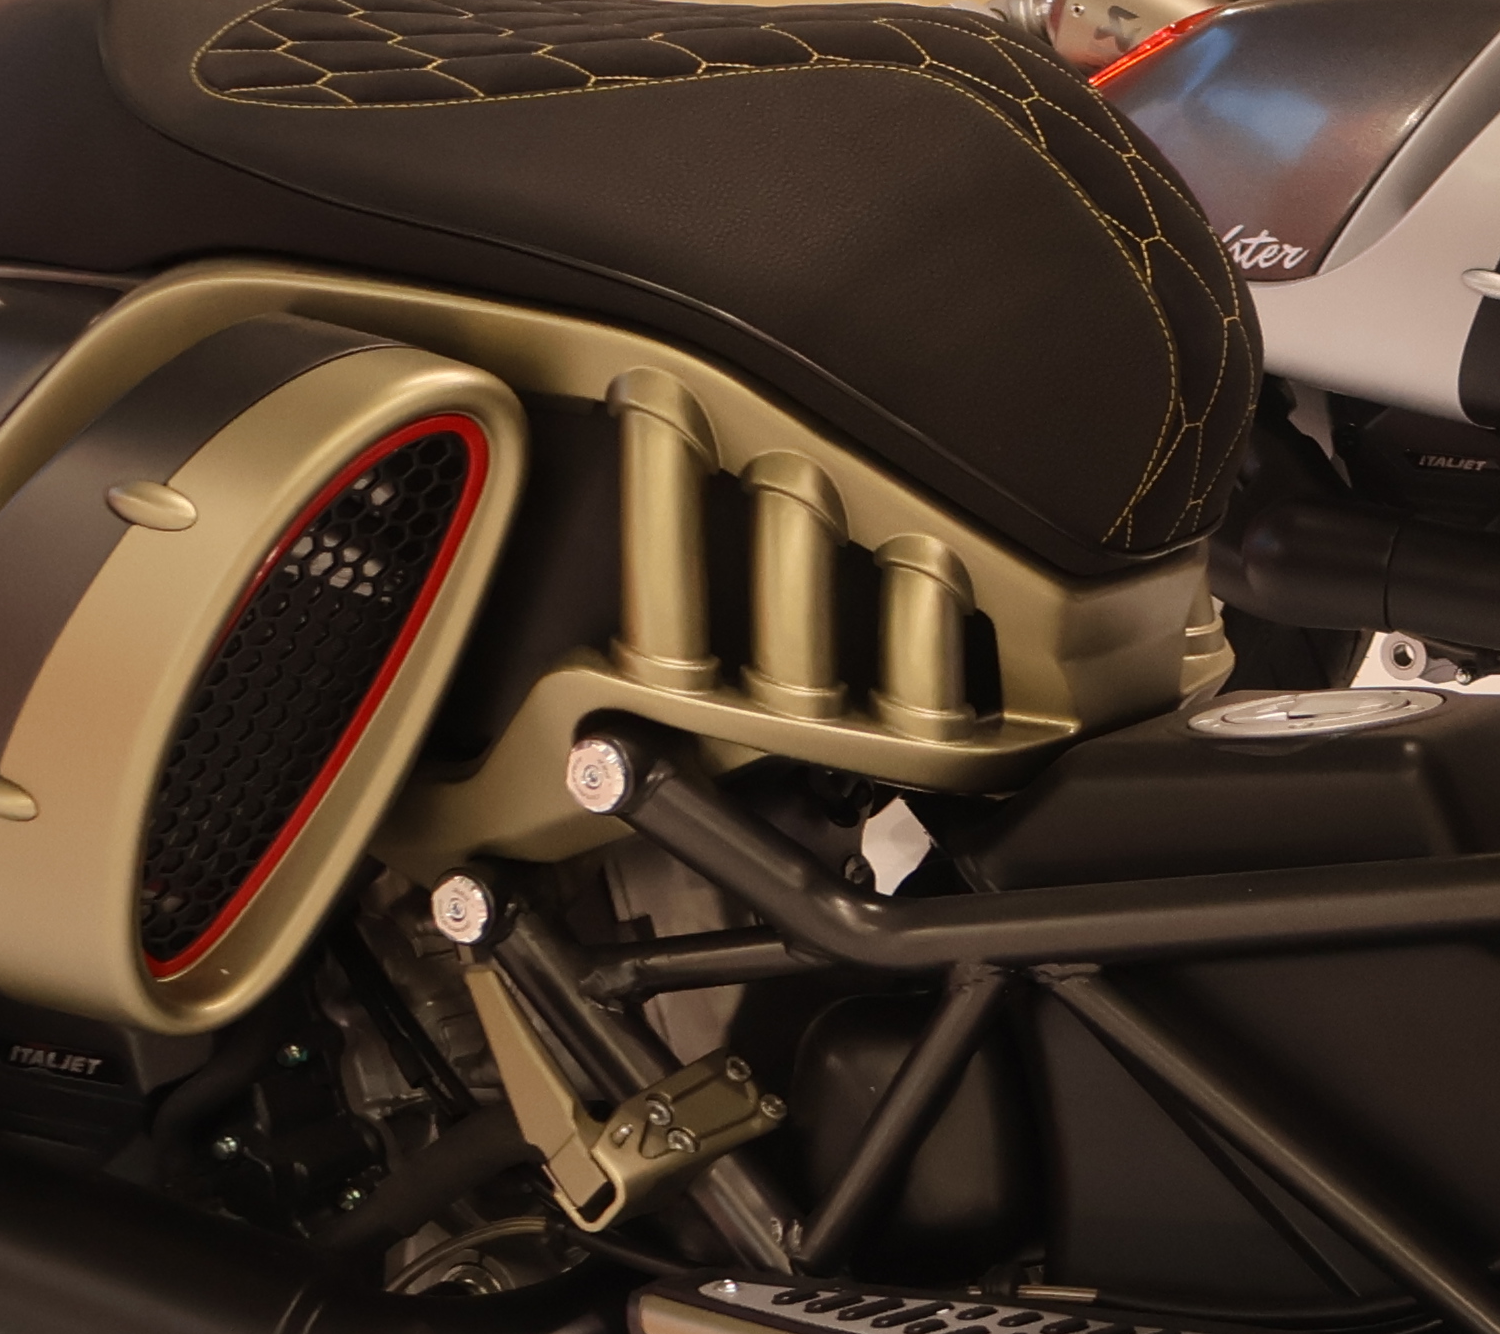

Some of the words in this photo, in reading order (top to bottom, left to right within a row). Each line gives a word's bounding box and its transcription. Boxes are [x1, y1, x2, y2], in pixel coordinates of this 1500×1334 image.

[1221, 224, 1310, 270] ster
[1418, 455, 1487, 471] ITALJET
[10, 1045, 103, 1075] ITALJET
